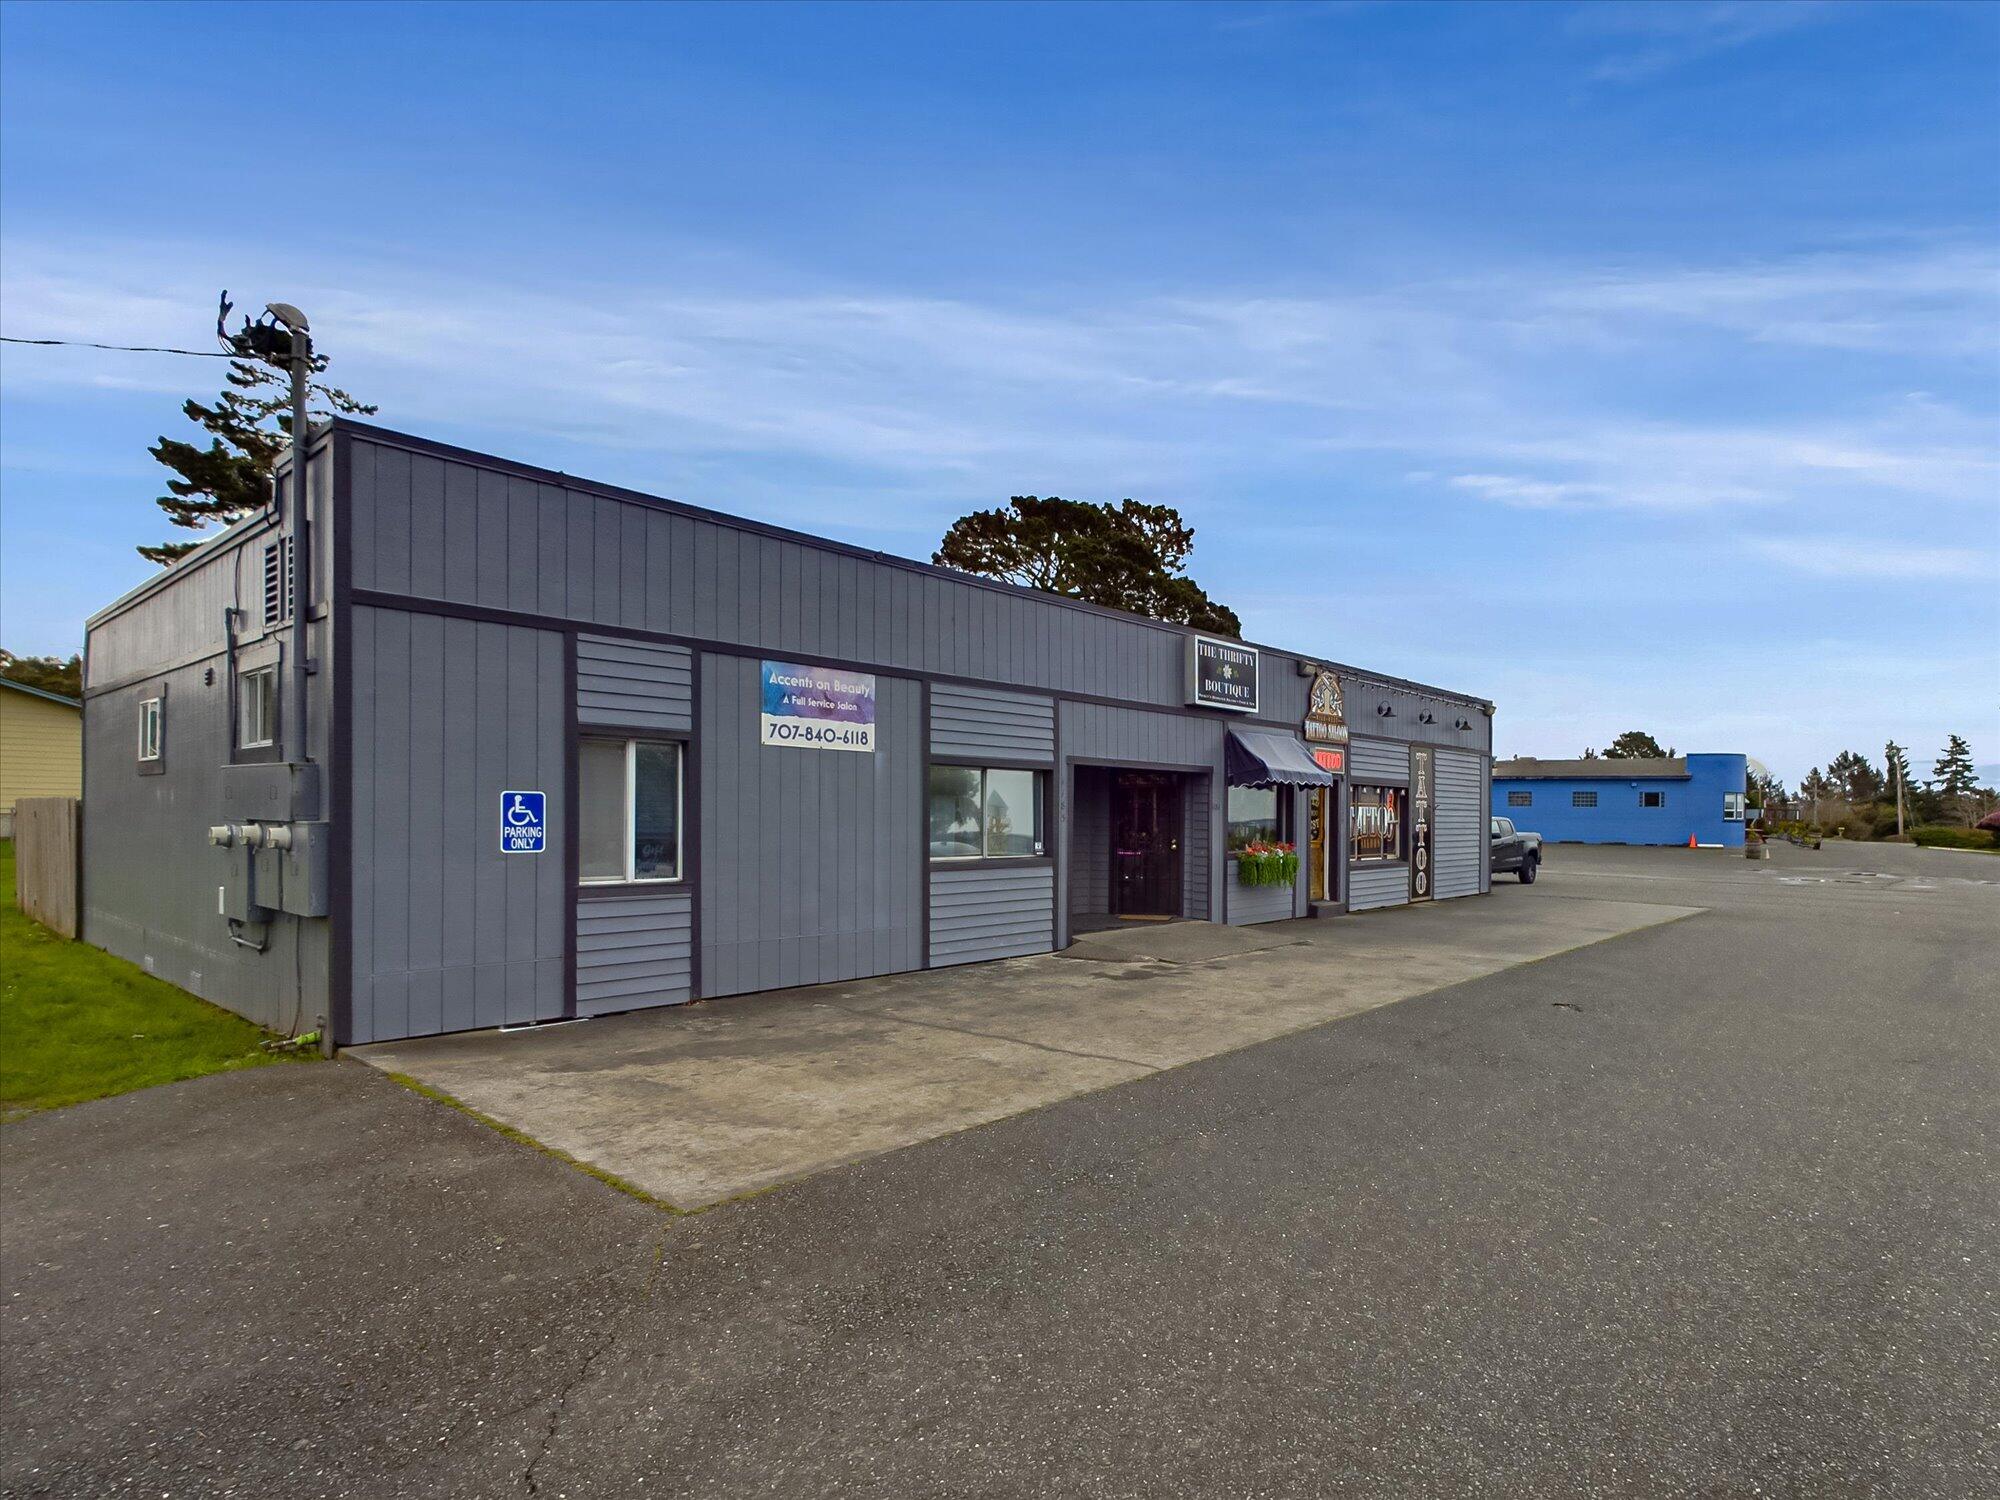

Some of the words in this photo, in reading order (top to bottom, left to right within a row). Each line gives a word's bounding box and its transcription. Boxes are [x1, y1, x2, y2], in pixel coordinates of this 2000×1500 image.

[1199, 643, 1217, 659] THE
[1218, 648, 1255, 667] THRIFTY
[769, 672, 813, 689] Accents
[816, 680, 830, 691] on
[834, 680, 870, 698] Beauty
[1205, 679, 1250, 698] BOUTIQUE
[783, 695, 789, 704] A
[792, 695, 806, 706] Full
[808, 697, 835, 709] Service
[837, 701, 858, 711] Salon
[769, 723, 869, 746] 707-840-6118
[504, 826, 543, 838] PARKING
[1415, 752, 1428, 895] TATTOO
[511, 838, 536, 849] ONLY
